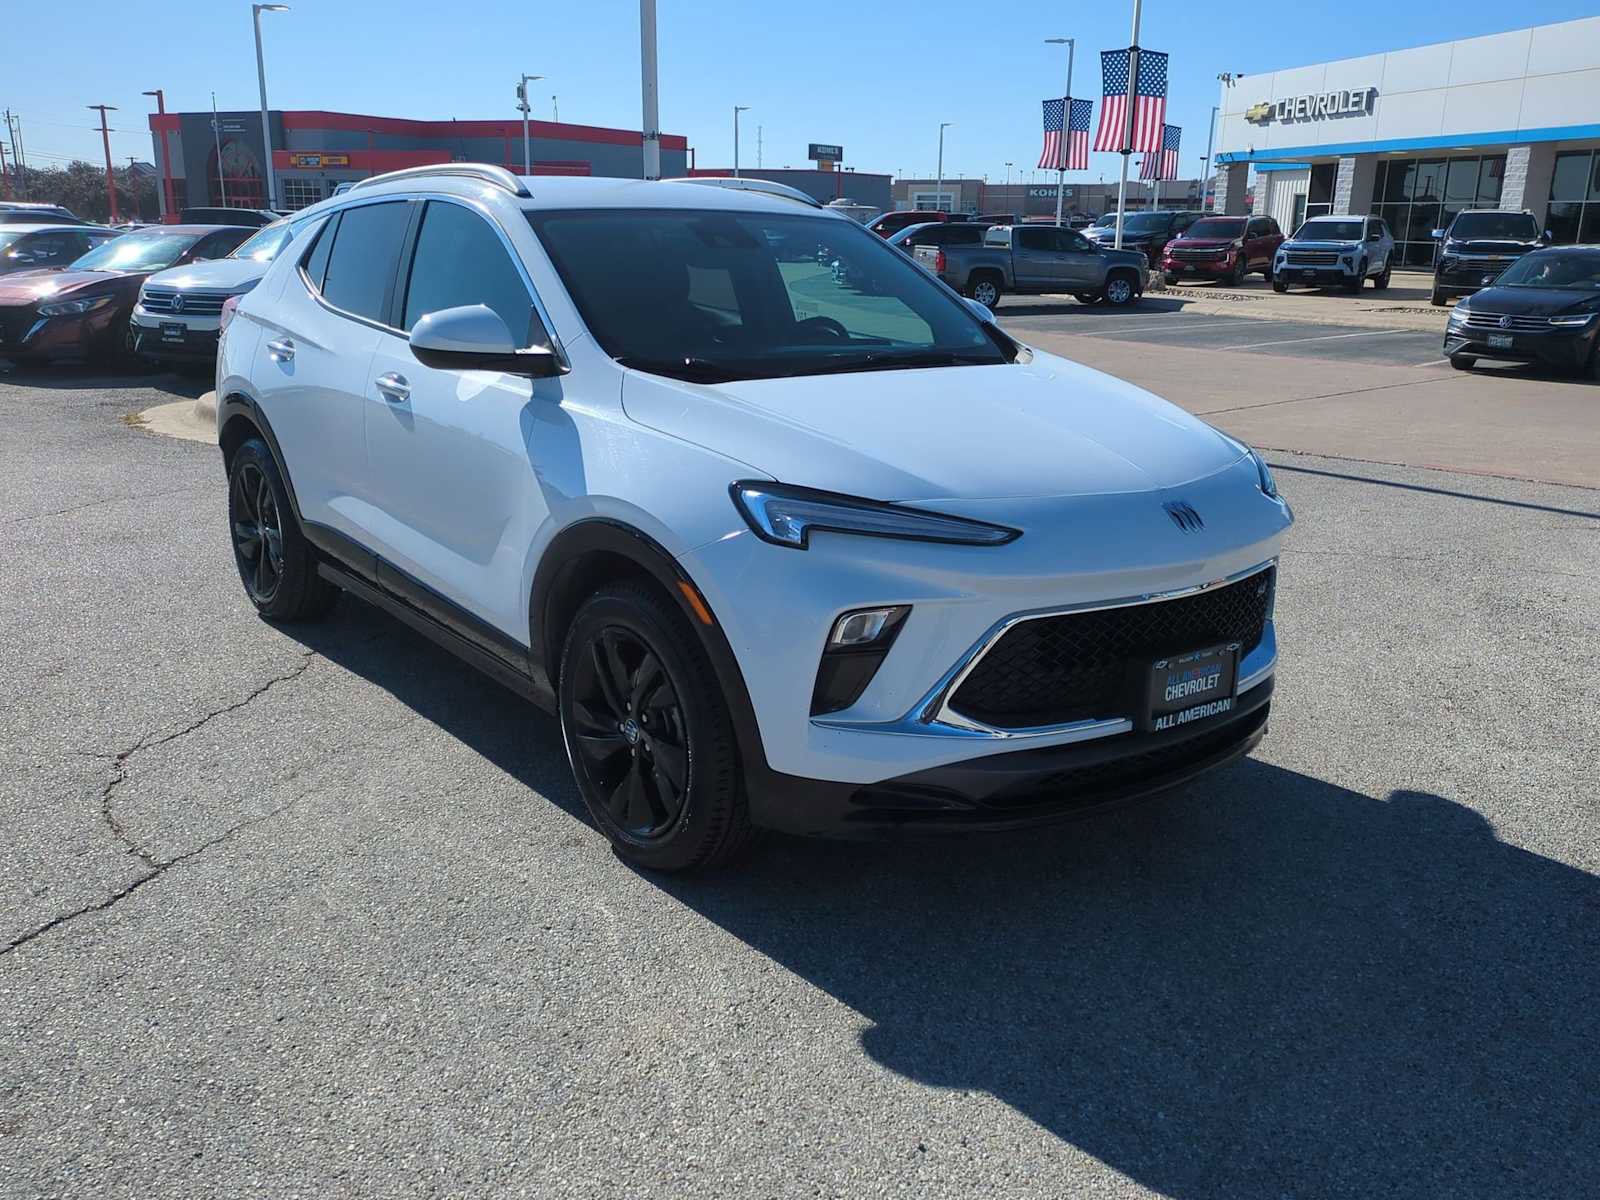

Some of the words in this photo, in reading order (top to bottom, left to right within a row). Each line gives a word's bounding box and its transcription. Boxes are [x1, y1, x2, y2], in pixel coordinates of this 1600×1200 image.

[1275, 87, 1374, 121] CHEVROLET
[1029, 188, 1073, 197] KOHS
[1165, 673, 1221, 702] CHEVROLET
[1155, 714, 1176, 731] ALL
[1177, 698, 1231, 725] AMERICAN
